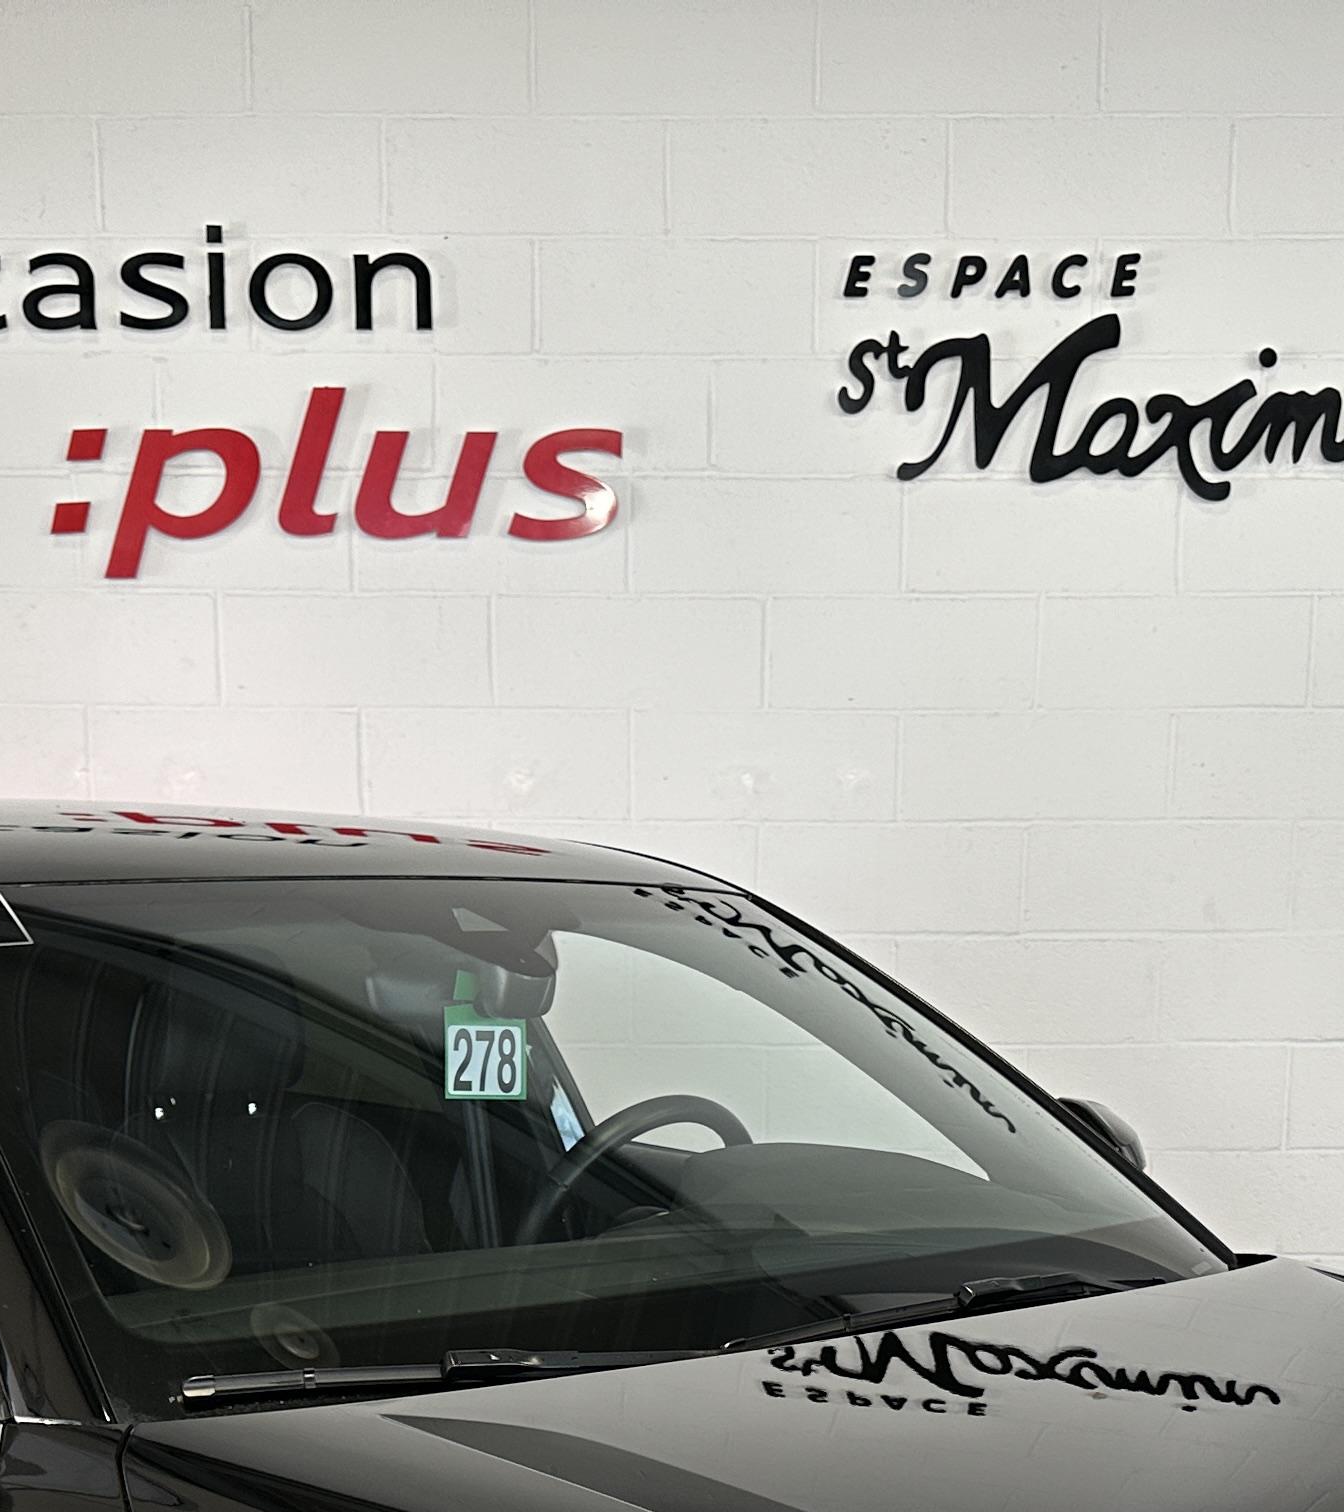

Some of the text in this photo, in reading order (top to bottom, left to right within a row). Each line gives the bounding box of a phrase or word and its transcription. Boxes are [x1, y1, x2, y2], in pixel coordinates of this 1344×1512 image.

[842, 252, 1142, 299] ESPACE
[837, 329, 909, 415] St
[51, 386, 623, 579] :plus
[452, 1025, 517, 1094] 278
